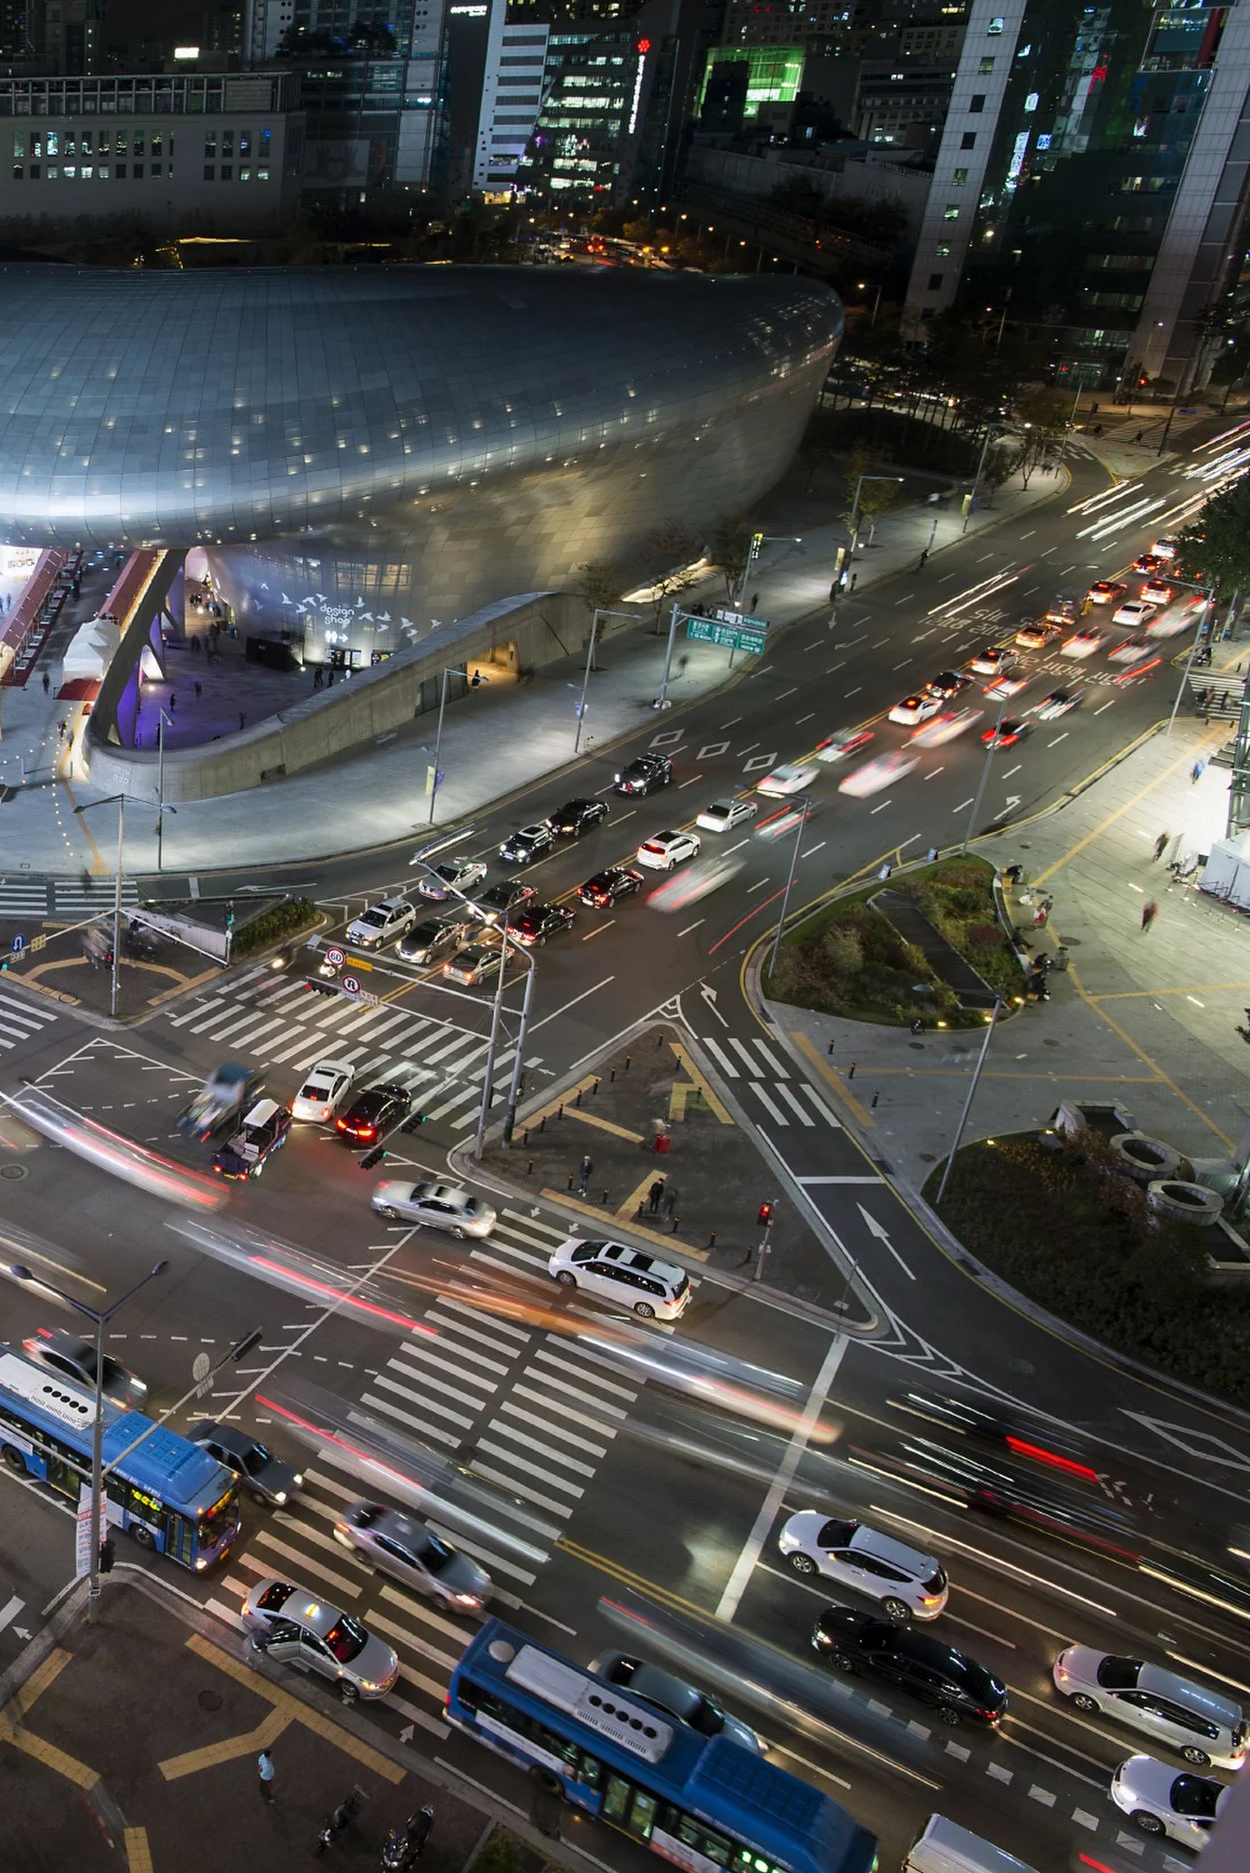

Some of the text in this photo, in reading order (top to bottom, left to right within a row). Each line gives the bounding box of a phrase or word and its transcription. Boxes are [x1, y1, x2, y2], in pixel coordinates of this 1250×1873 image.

[320, 604, 355, 617] design
[324, 615, 350, 626] shop
[330, 952, 342, 962] 60
